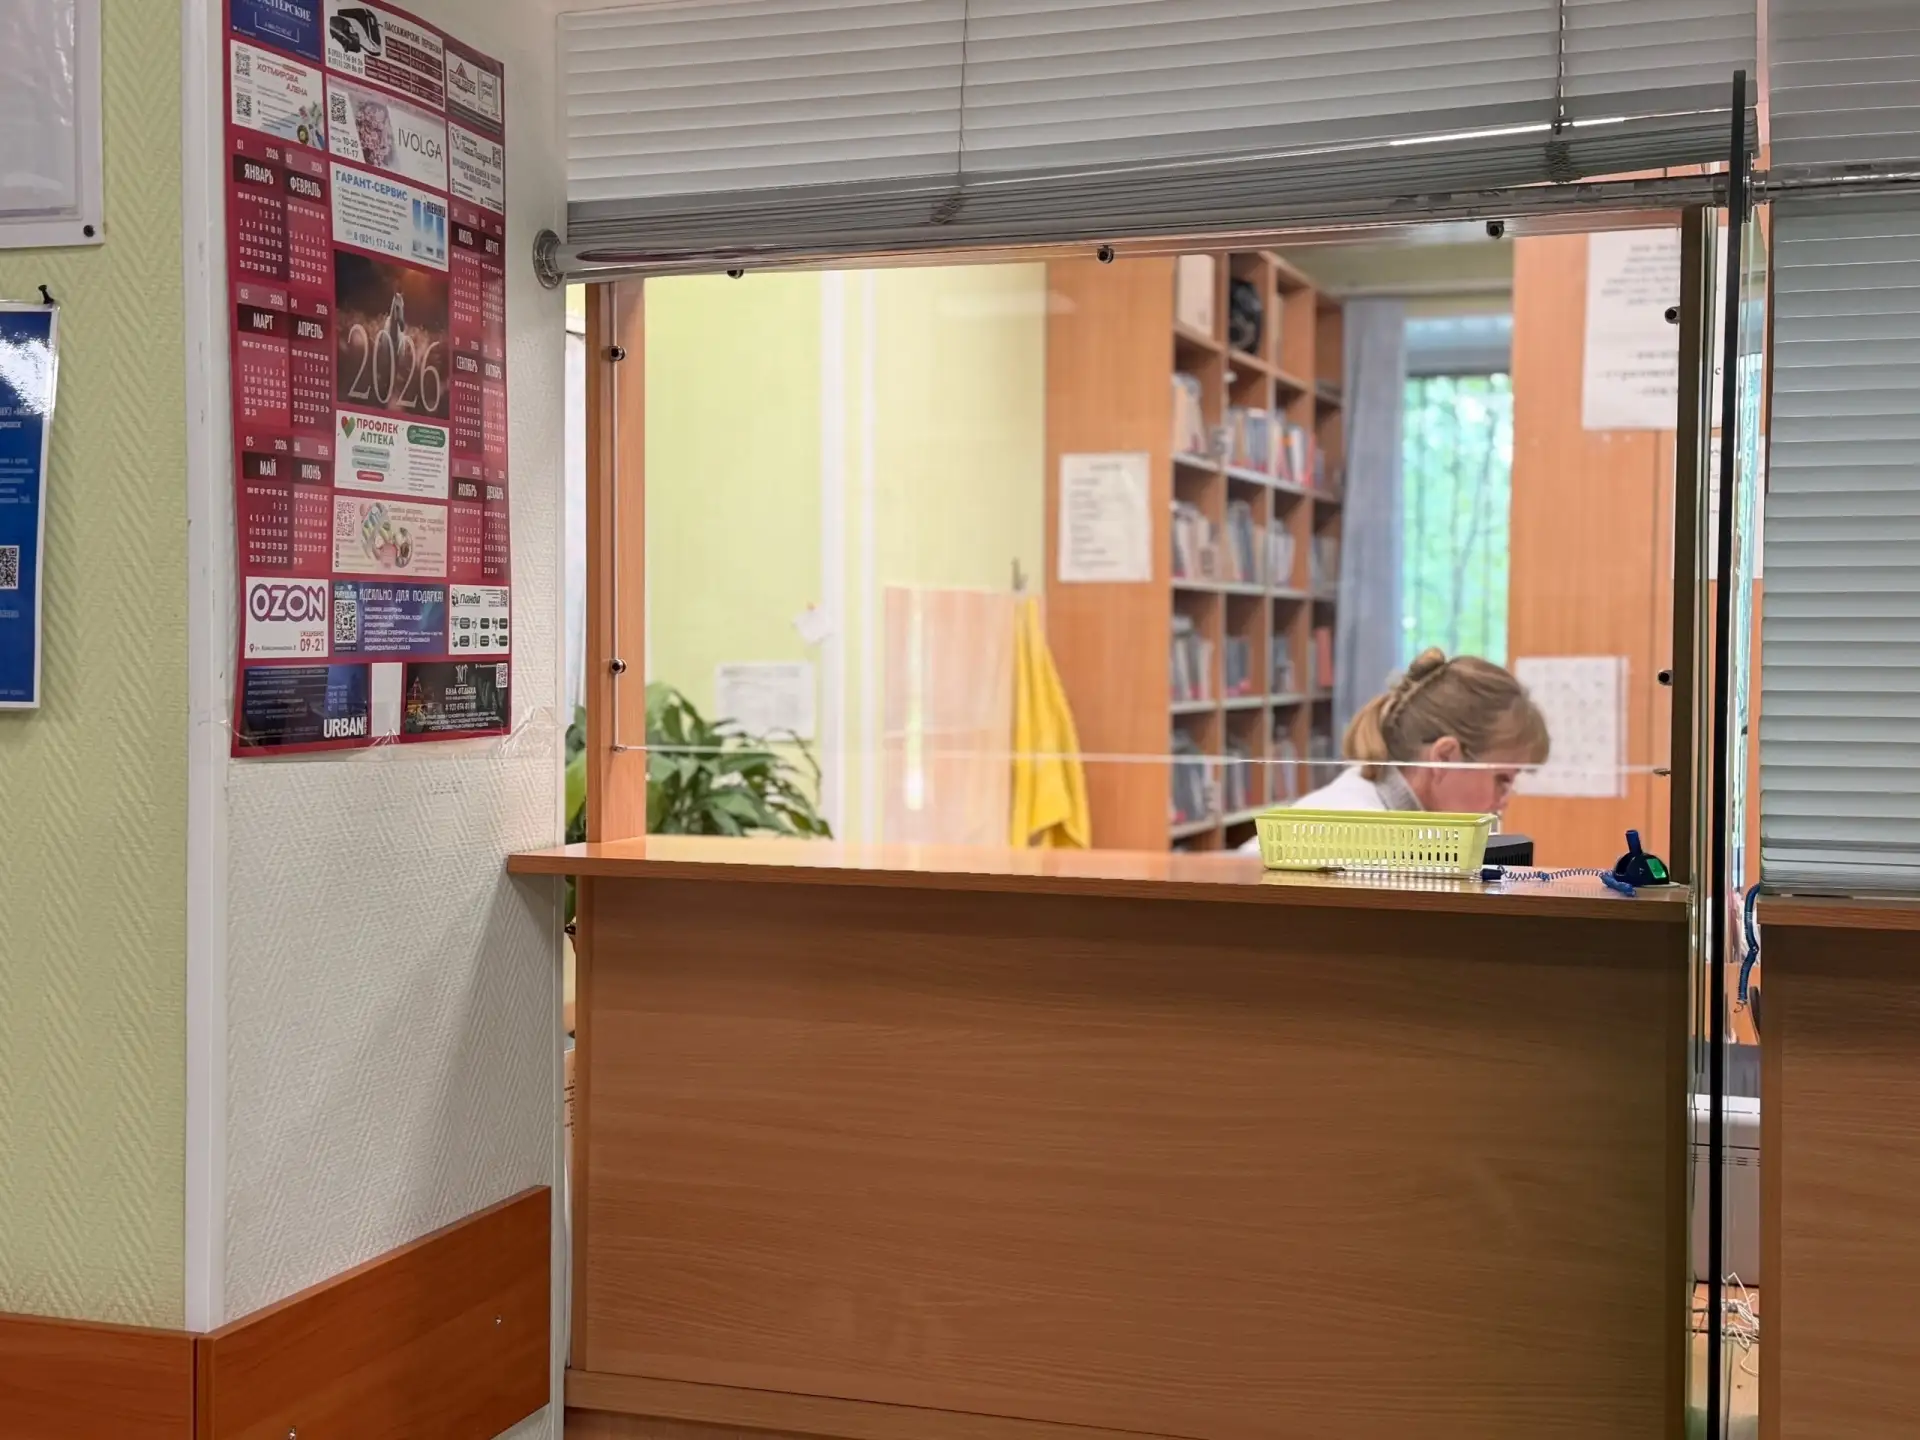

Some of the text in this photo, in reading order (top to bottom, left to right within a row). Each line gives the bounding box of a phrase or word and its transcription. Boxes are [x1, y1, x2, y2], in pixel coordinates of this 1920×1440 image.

[237, 139, 243, 150] 01
[343, 136, 359, 149] 10-20
[398, 128, 443, 162] IVOLGA
[266, 147, 279, 160] 2026
[286, 153, 293, 164] 02
[343, 147, 359, 159] 11-17
[244, 163, 274, 185] ЯНВАРЬ
[311, 161, 322, 173] 2026
[290, 176, 321, 198] ФЕВРАЛЬ
[336, 171, 408, 202] ГАРАНТ-СЕРВИС
[241, 288, 248, 299] 03
[270, 294, 284, 306] 2026
[291, 298, 298, 309] 04
[316, 303, 328, 315] 2026
[253, 312, 273, 330] МАРТ
[298, 320, 324, 339] АПРЕЛЬ
[348, 324, 440, 412] 2026
[357, 418, 398, 434] ПРОФЛЕК
[246, 435, 254, 447] 05
[275, 439, 287, 450] 2026
[360, 432, 394, 446] АПТЕКА
[260, 458, 276, 476] МАЙ
[302, 464, 321, 480] ИЮНЬ
[459, 483, 477, 497] НОЯБРЬ
[250, 584, 325, 622] OZON
[359, 588, 392, 604] ИДЕАЛЬНО
[396, 589, 410, 604] ДЛЯ
[413, 590, 444, 604] ПОДАРКА!
[460, 593, 480, 605] Панда
[324, 717, 364, 738] URBAN
